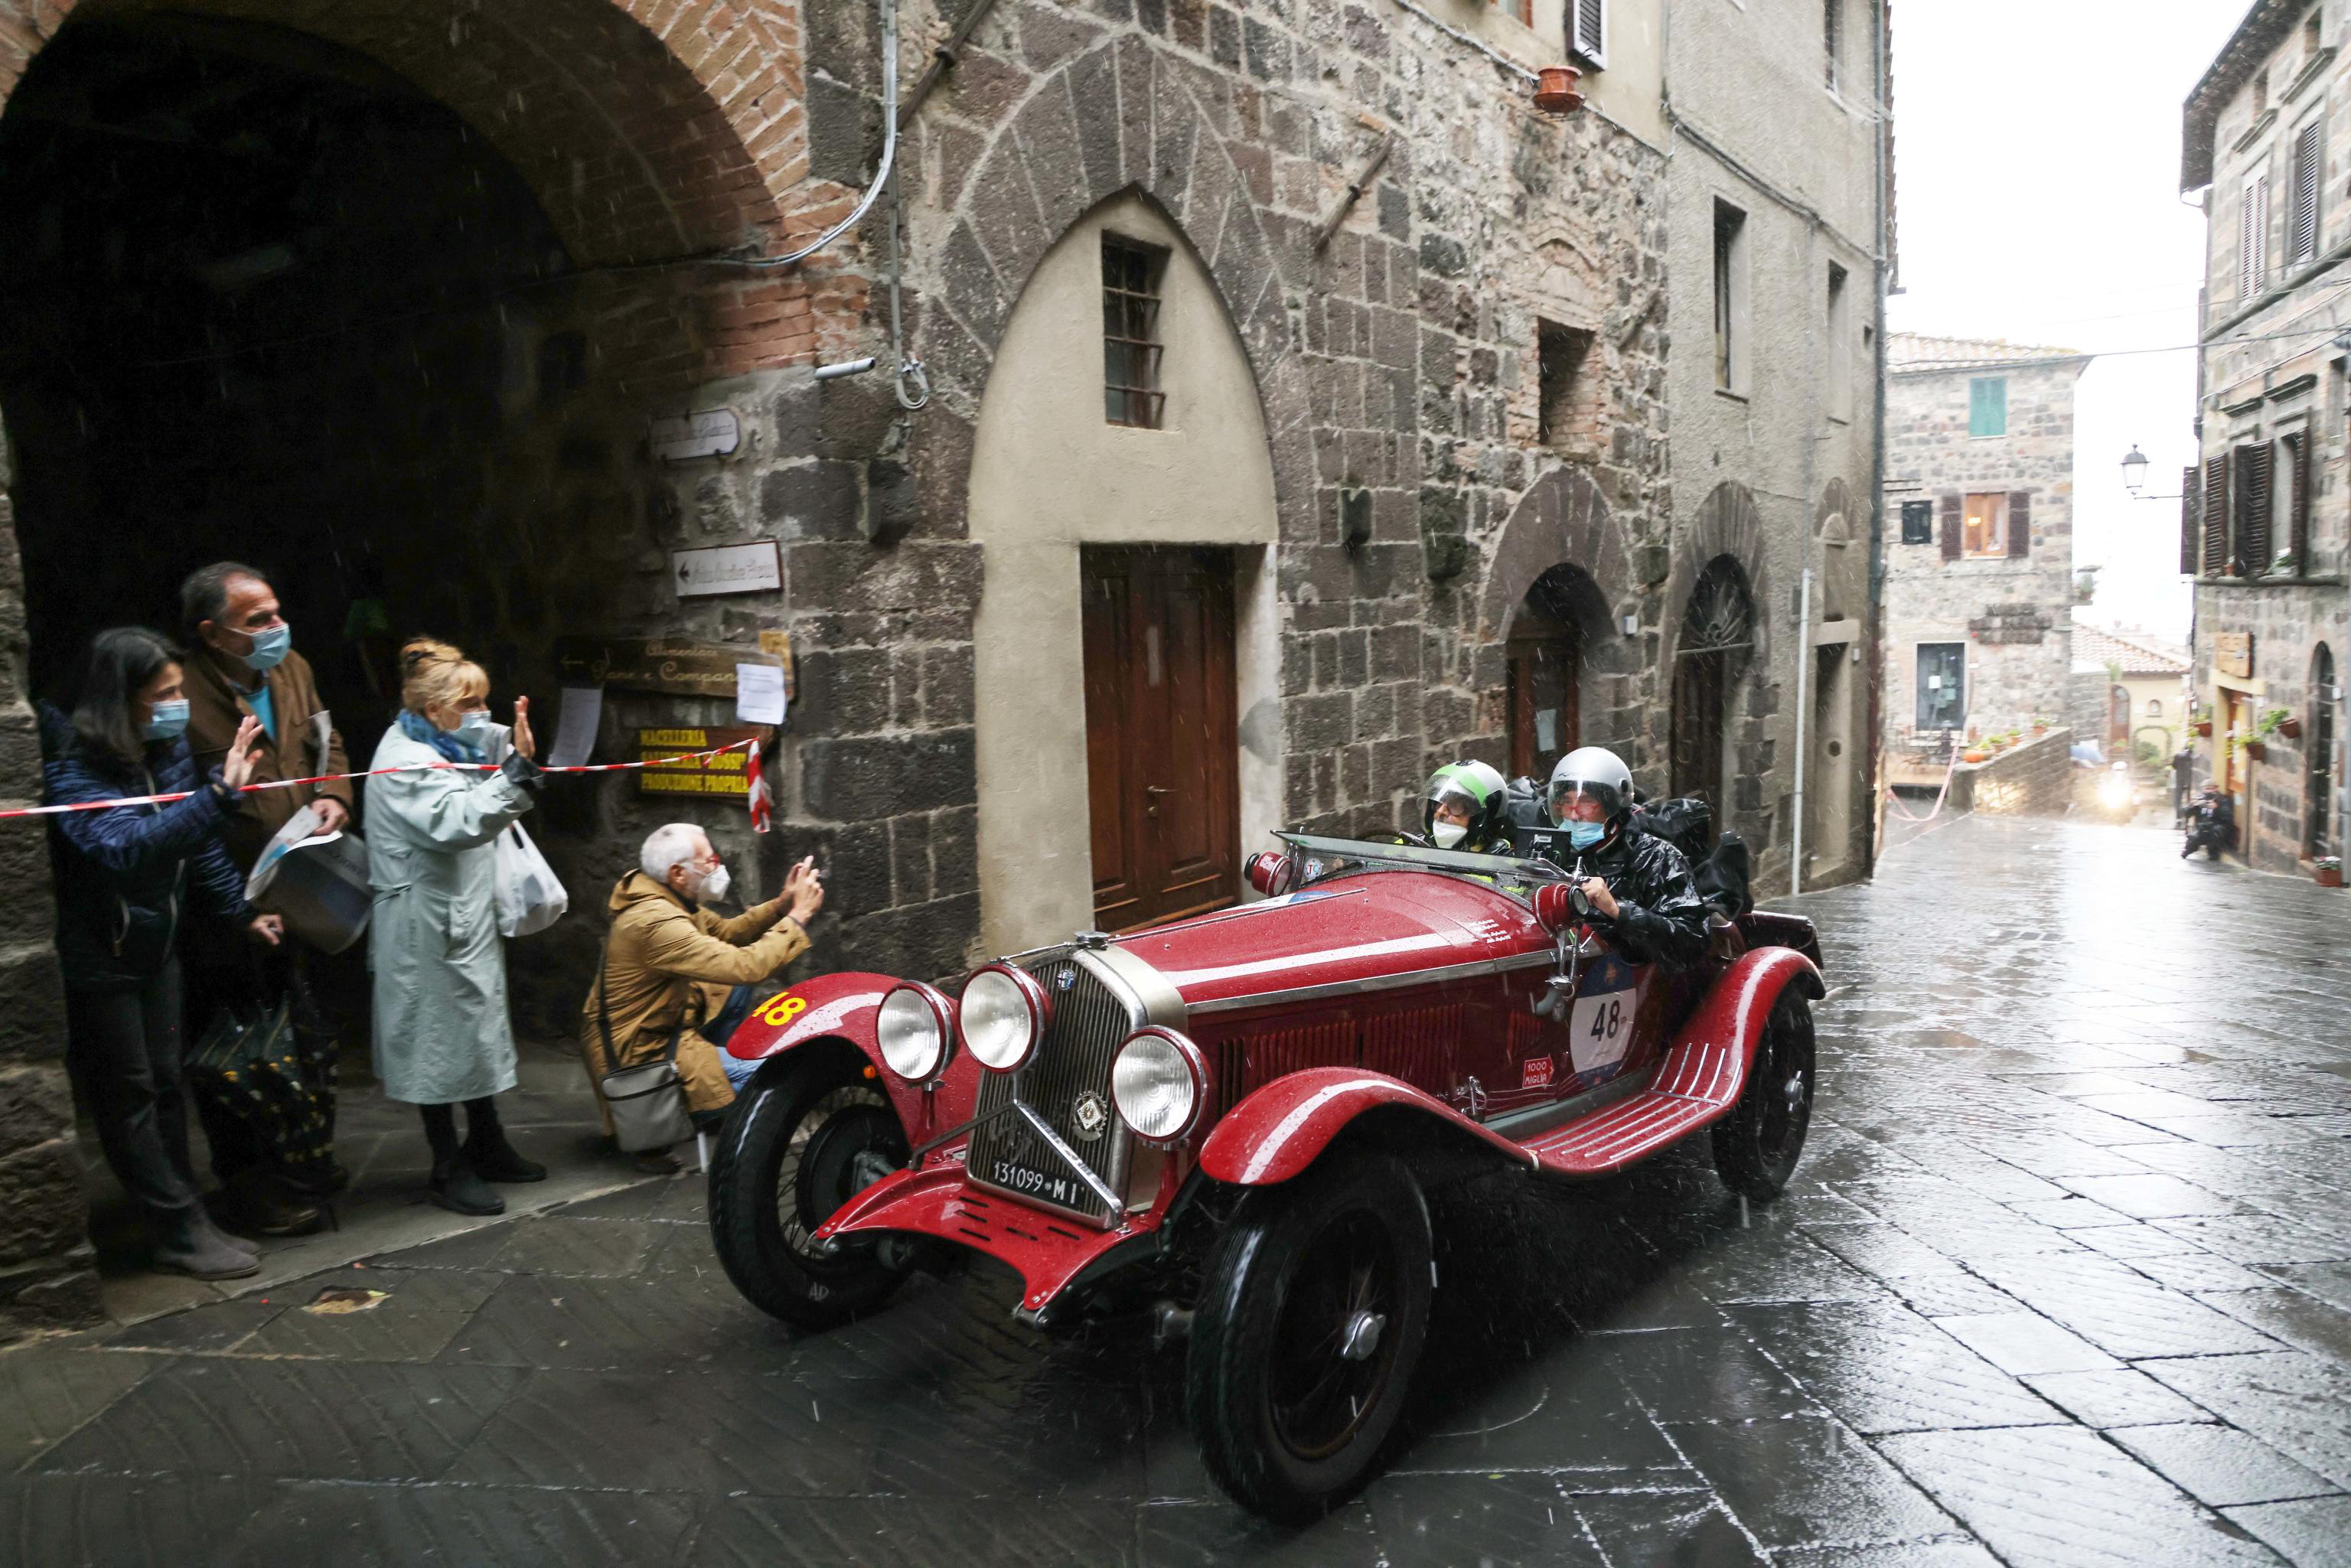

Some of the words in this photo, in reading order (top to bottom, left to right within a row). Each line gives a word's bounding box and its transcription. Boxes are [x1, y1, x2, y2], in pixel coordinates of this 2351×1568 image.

[752, 992, 807, 1026] 48
[1590, 999, 1621, 1042] 48
[1527, 1061, 1547, 1072] 1000
[1524, 1074, 1547, 1087] MIGLIA
